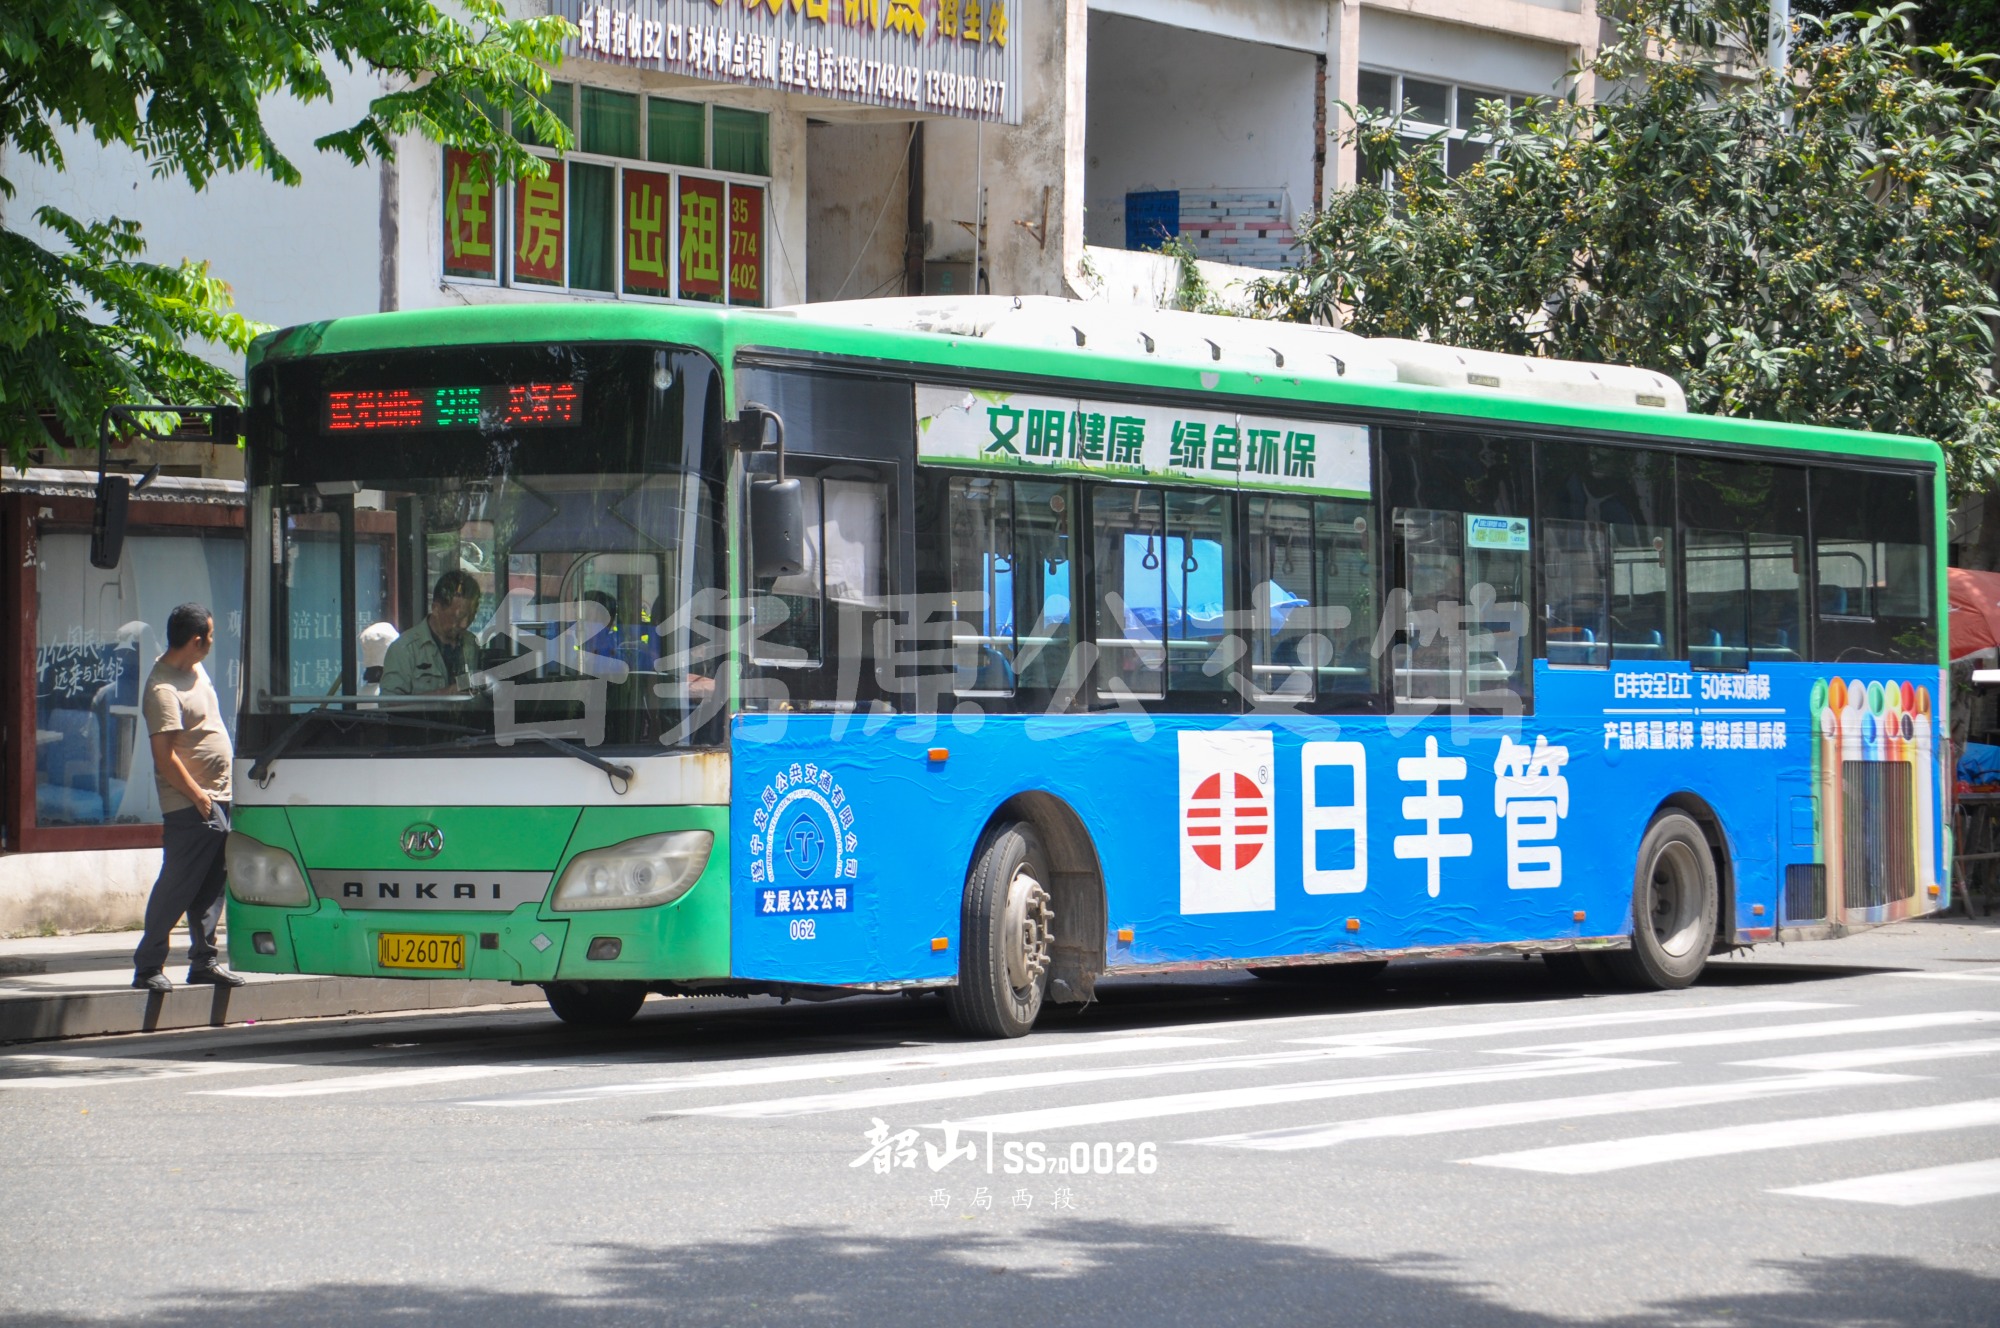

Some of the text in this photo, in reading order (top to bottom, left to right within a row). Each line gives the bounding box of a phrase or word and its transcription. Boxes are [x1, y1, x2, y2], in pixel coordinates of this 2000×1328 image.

[666, 23, 682, 61] C1
[687, 24, 775, 81] 对外钟点培训
[446, 162, 719, 284] 住房出租
[732, 197, 749, 223] 35
[732, 230, 757, 257] 774
[731, 263, 757, 289] 402
[984, 405, 1316, 478] 文明健康 绿色环保
[1701, 674, 1772, 700] 50年双质保
[1604, 720, 1787, 750] 产品质量质保 焊接质量质保
[751, 763, 858, 883] 遂宁发展公共交通有限公司
[1301, 735, 1570, 898] 日丰管
[343, 882, 500, 899] ANKAI
[762, 888, 847, 914] 发展公交公司
[791, 919, 816, 940] 062
